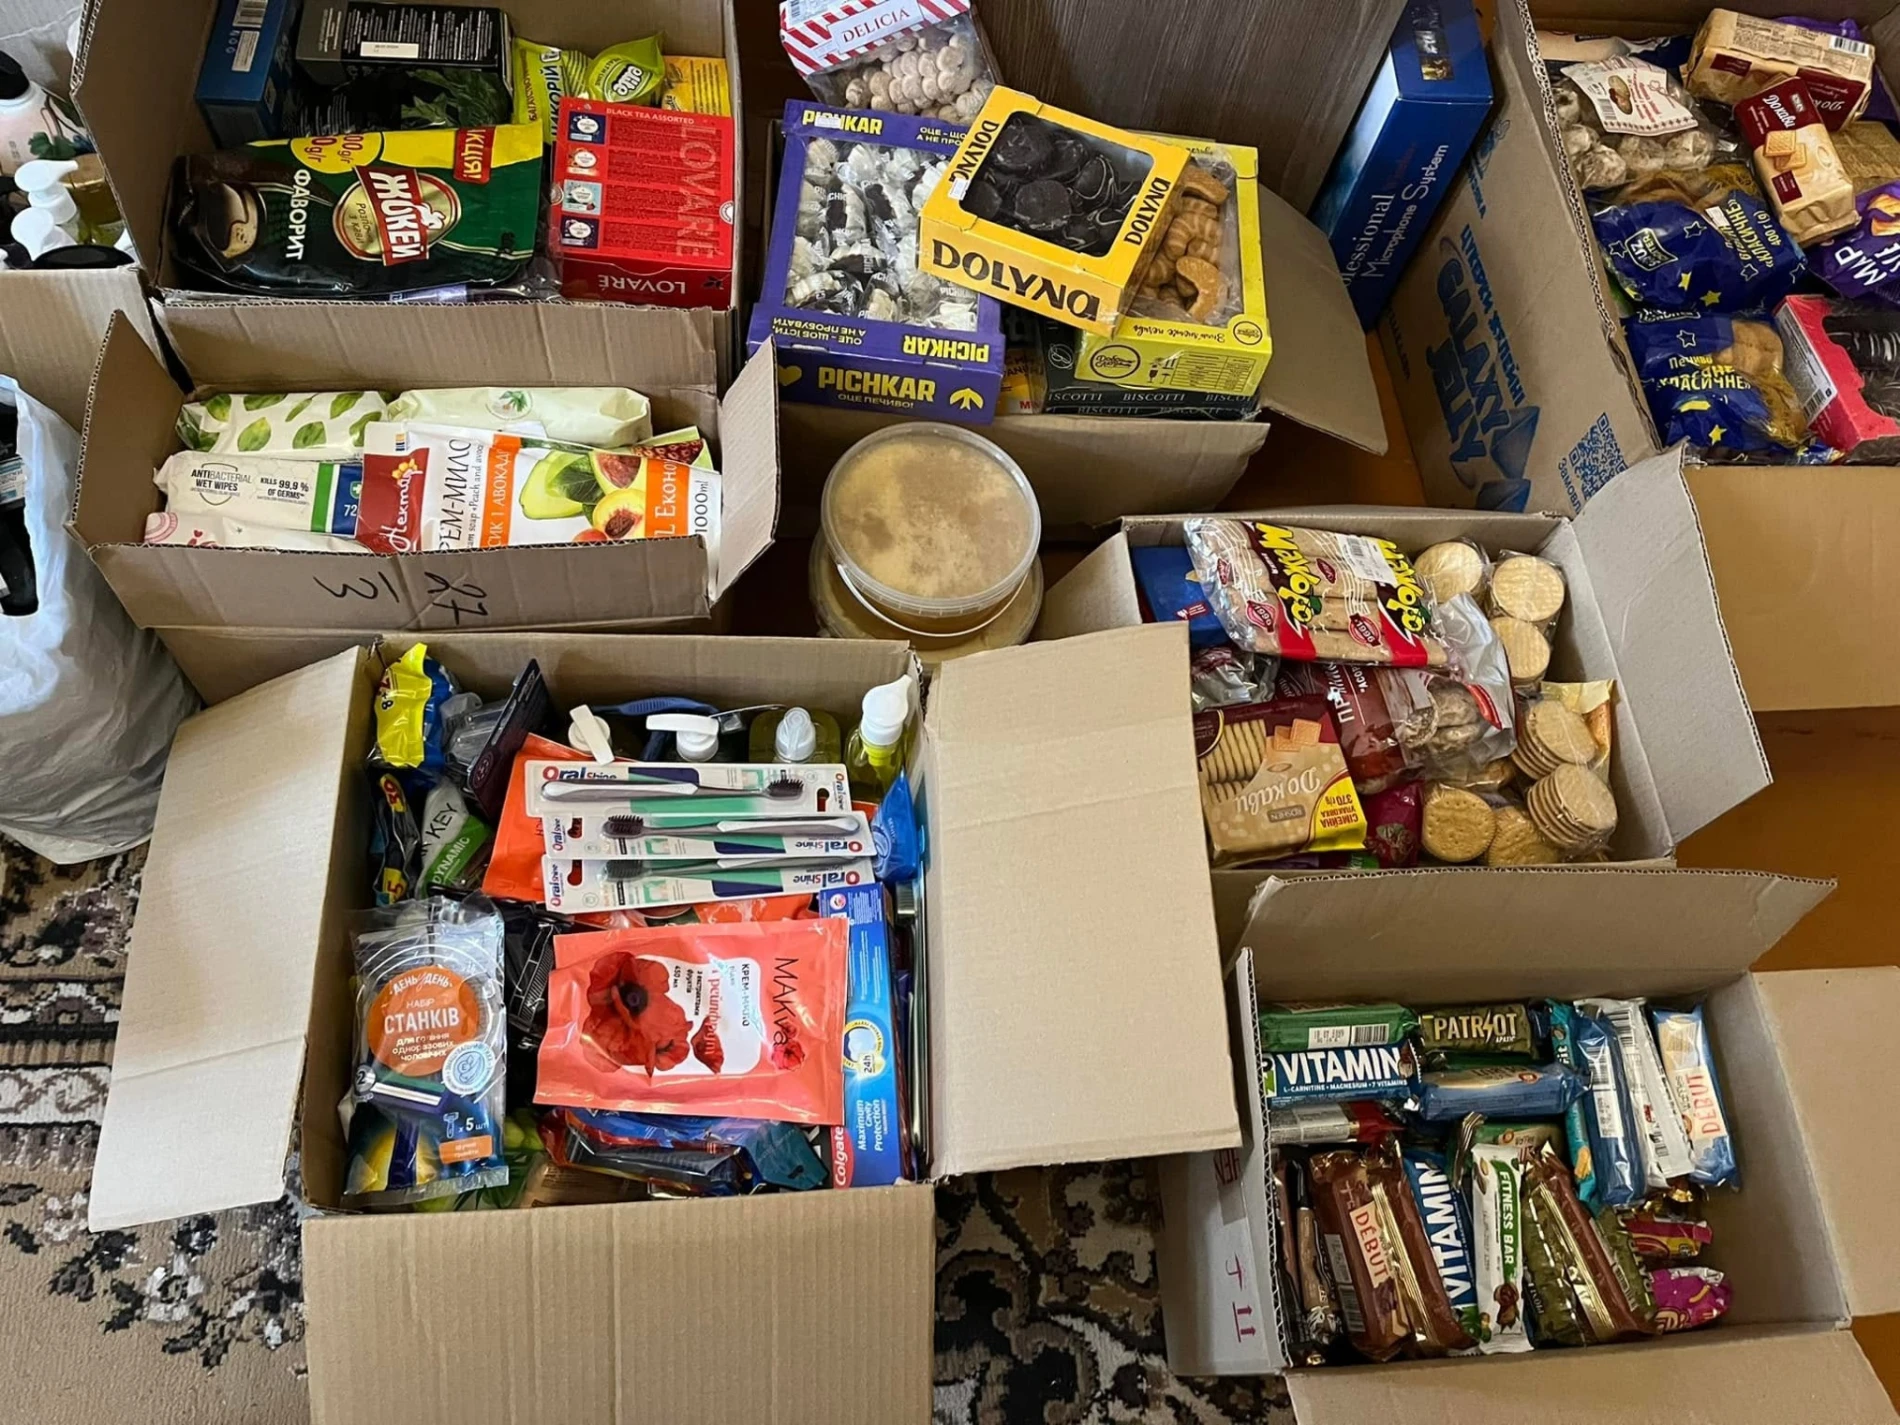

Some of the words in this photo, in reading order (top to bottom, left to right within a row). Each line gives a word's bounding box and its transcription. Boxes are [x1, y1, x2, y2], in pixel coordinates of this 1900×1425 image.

[842, 9, 911, 43] DELICIA
[606, 108, 632, 119] BLACK
[634, 110, 651, 121] TEA
[652, 112, 695, 125] ASSORTED
[285, 169, 311, 260] ФАВОРИТ
[368, 171, 423, 259] ЖОКЕЙ
[1363, 182, 1418, 279] Microphone
[1405, 143, 1450, 200] System
[1762, 226, 1783, 247] 400
[598, 273, 687, 295] LOVARÉ
[903, 335, 989, 362] PICHKAR
[1436, 248, 1511, 438] GALAXY
[818, 366, 936, 402] PICHKAR
[1048, 393, 1103, 402] ISCOTTI
[1122, 392, 1185, 402] BISCOTTI
[1426, 343, 1488, 464] JELLY
[191, 468, 252, 484] ANTIBACTERIAL
[195, 478, 213, 489] WET
[214, 480, 238, 492] WIPES
[267, 488, 276, 497] OF
[1336, 794, 1353, 805] 370
[426, 802, 459, 839] KEY
[1321, 813, 1359, 828] СІМЕЙНА
[432, 835, 470, 885] DYNAMIC
[384, 1007, 460, 1035] СТАНКІВ
[356, 1070, 367, 1085] 2
[863, 1054, 873, 1074] 24h
[1277, 1046, 1400, 1085] VITAMIN
[1284, 1084, 1325, 1093] L-CARNITINE
[1330, 1082, 1368, 1090] MAGNESIUM
[1377, 1079, 1409, 1087] VITAMINS
[1685, 1073, 1722, 1135] DÉBUT
[465, 1117, 475, 1132] 5
[855, 1099, 866, 1151] Maximum
[873, 1099, 883, 1151] Protection
[834, 1126, 846, 1187] Colgate
[1499, 1170, 1515, 1231] FITNESS
[1414, 1162, 1473, 1300] VITAMIN
[1503, 1237, 1516, 1265] BAR
